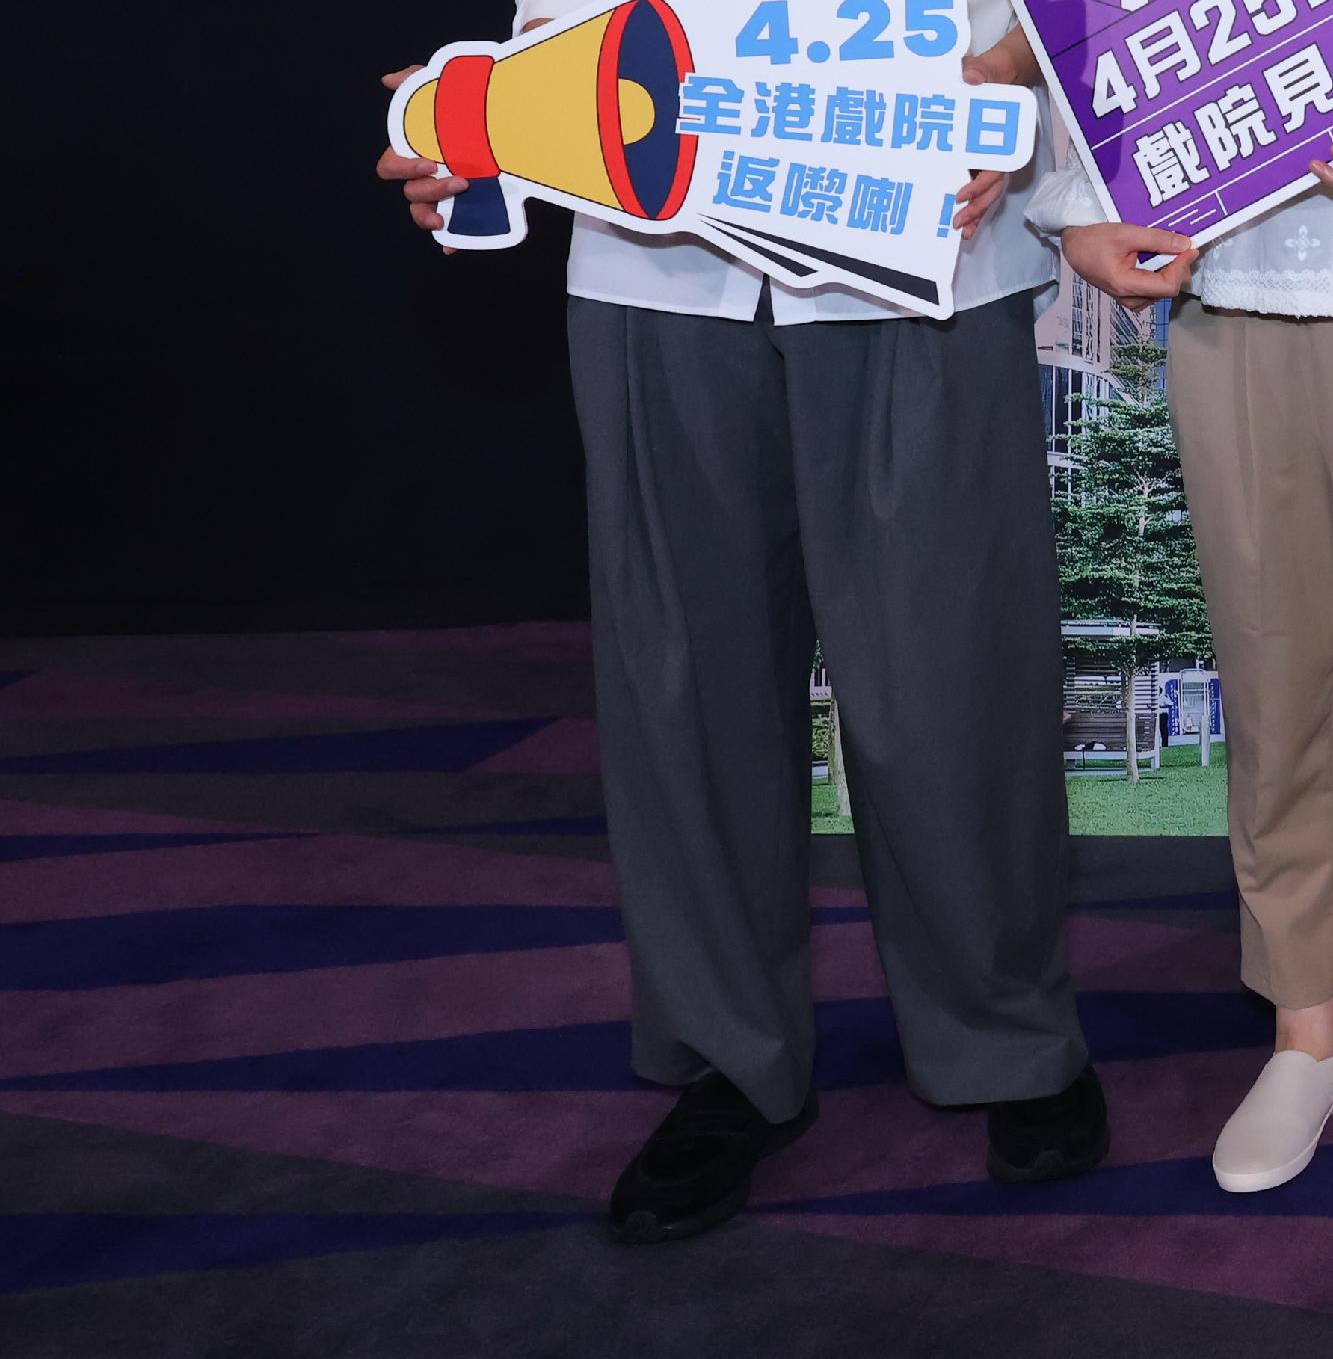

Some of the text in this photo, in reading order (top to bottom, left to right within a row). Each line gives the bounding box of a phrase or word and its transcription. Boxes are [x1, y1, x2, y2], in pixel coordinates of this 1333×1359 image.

[678, 75, 1021, 156] 全港戲院日
